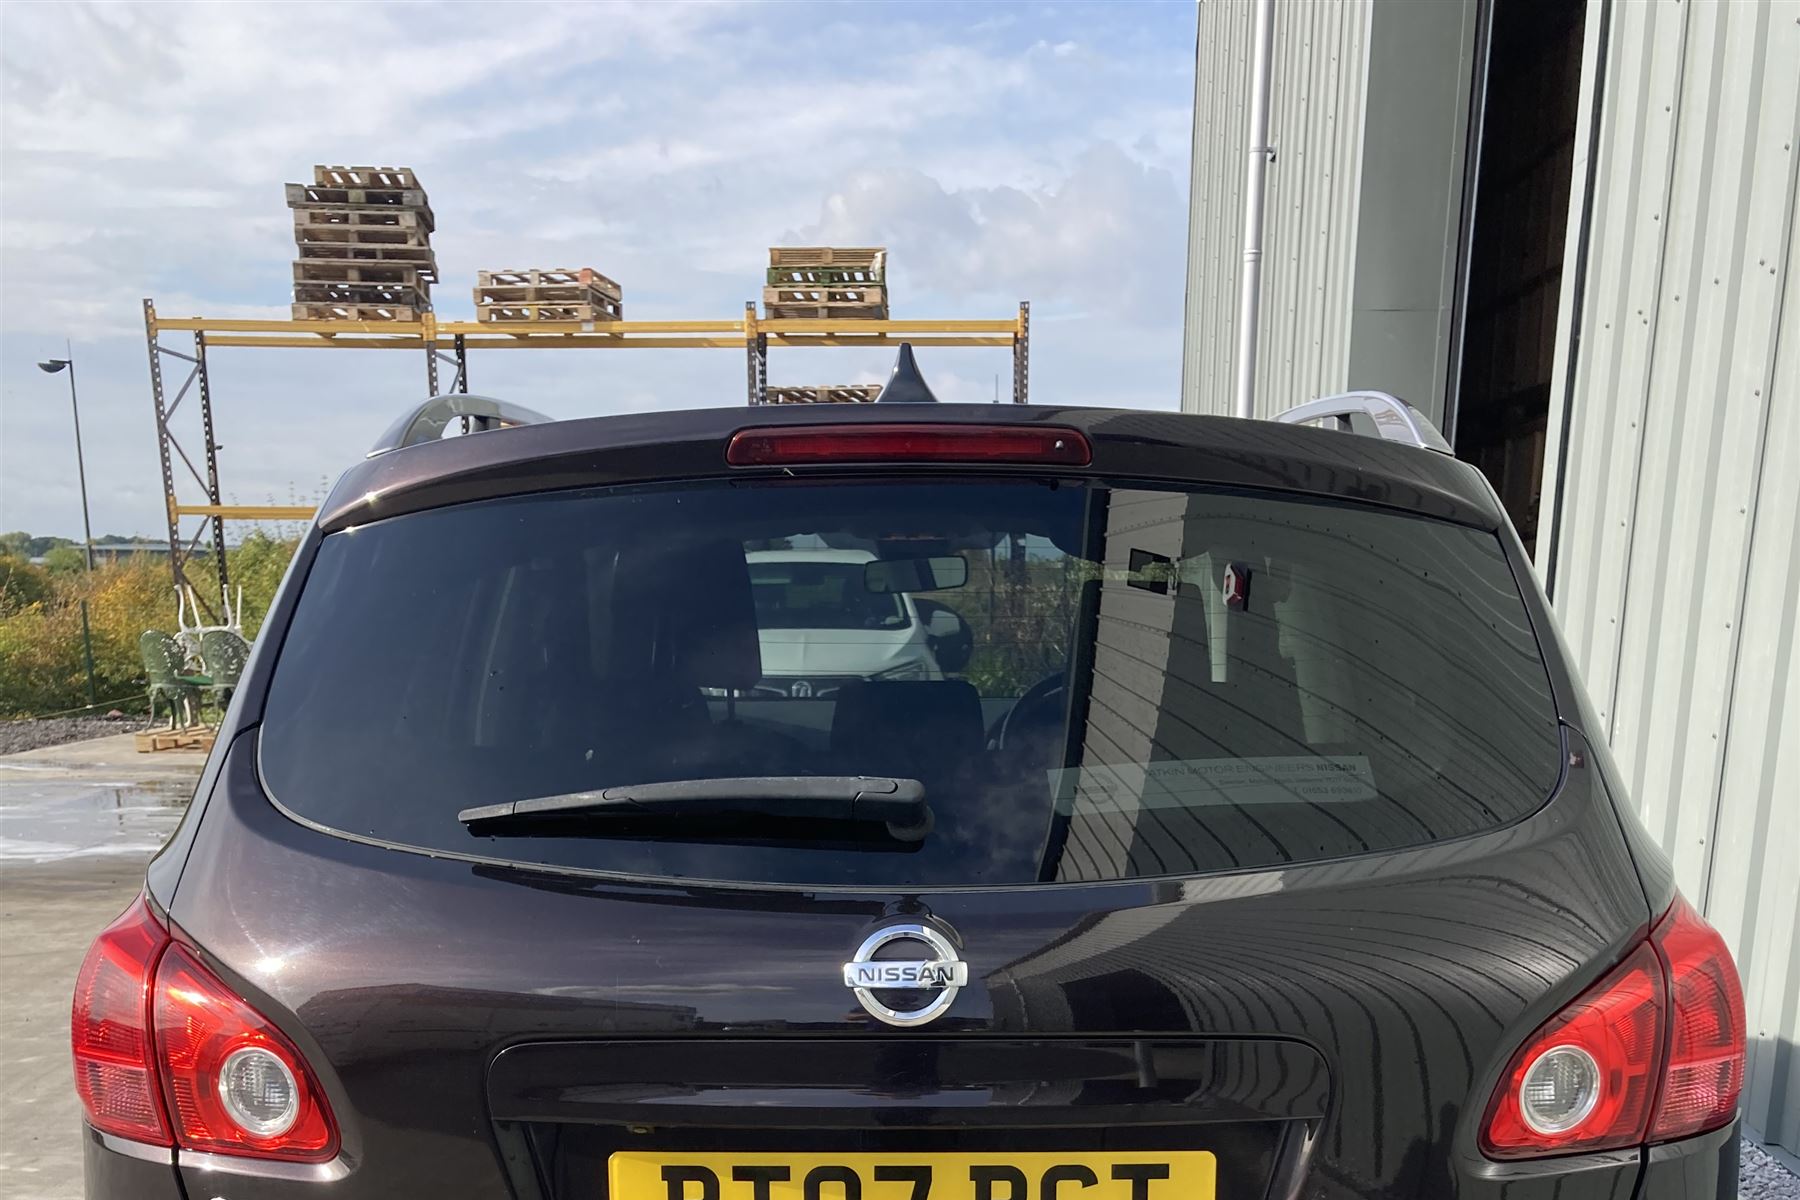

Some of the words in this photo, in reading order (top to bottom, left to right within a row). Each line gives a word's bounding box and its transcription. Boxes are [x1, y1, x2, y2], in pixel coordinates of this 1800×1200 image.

[1188, 765, 1232, 775] MOTOR
[1236, 763, 1314, 774] ENGINEERS
[1316, 763, 1357, 772] NISSAN
[858, 966, 954, 982] NISSAN
